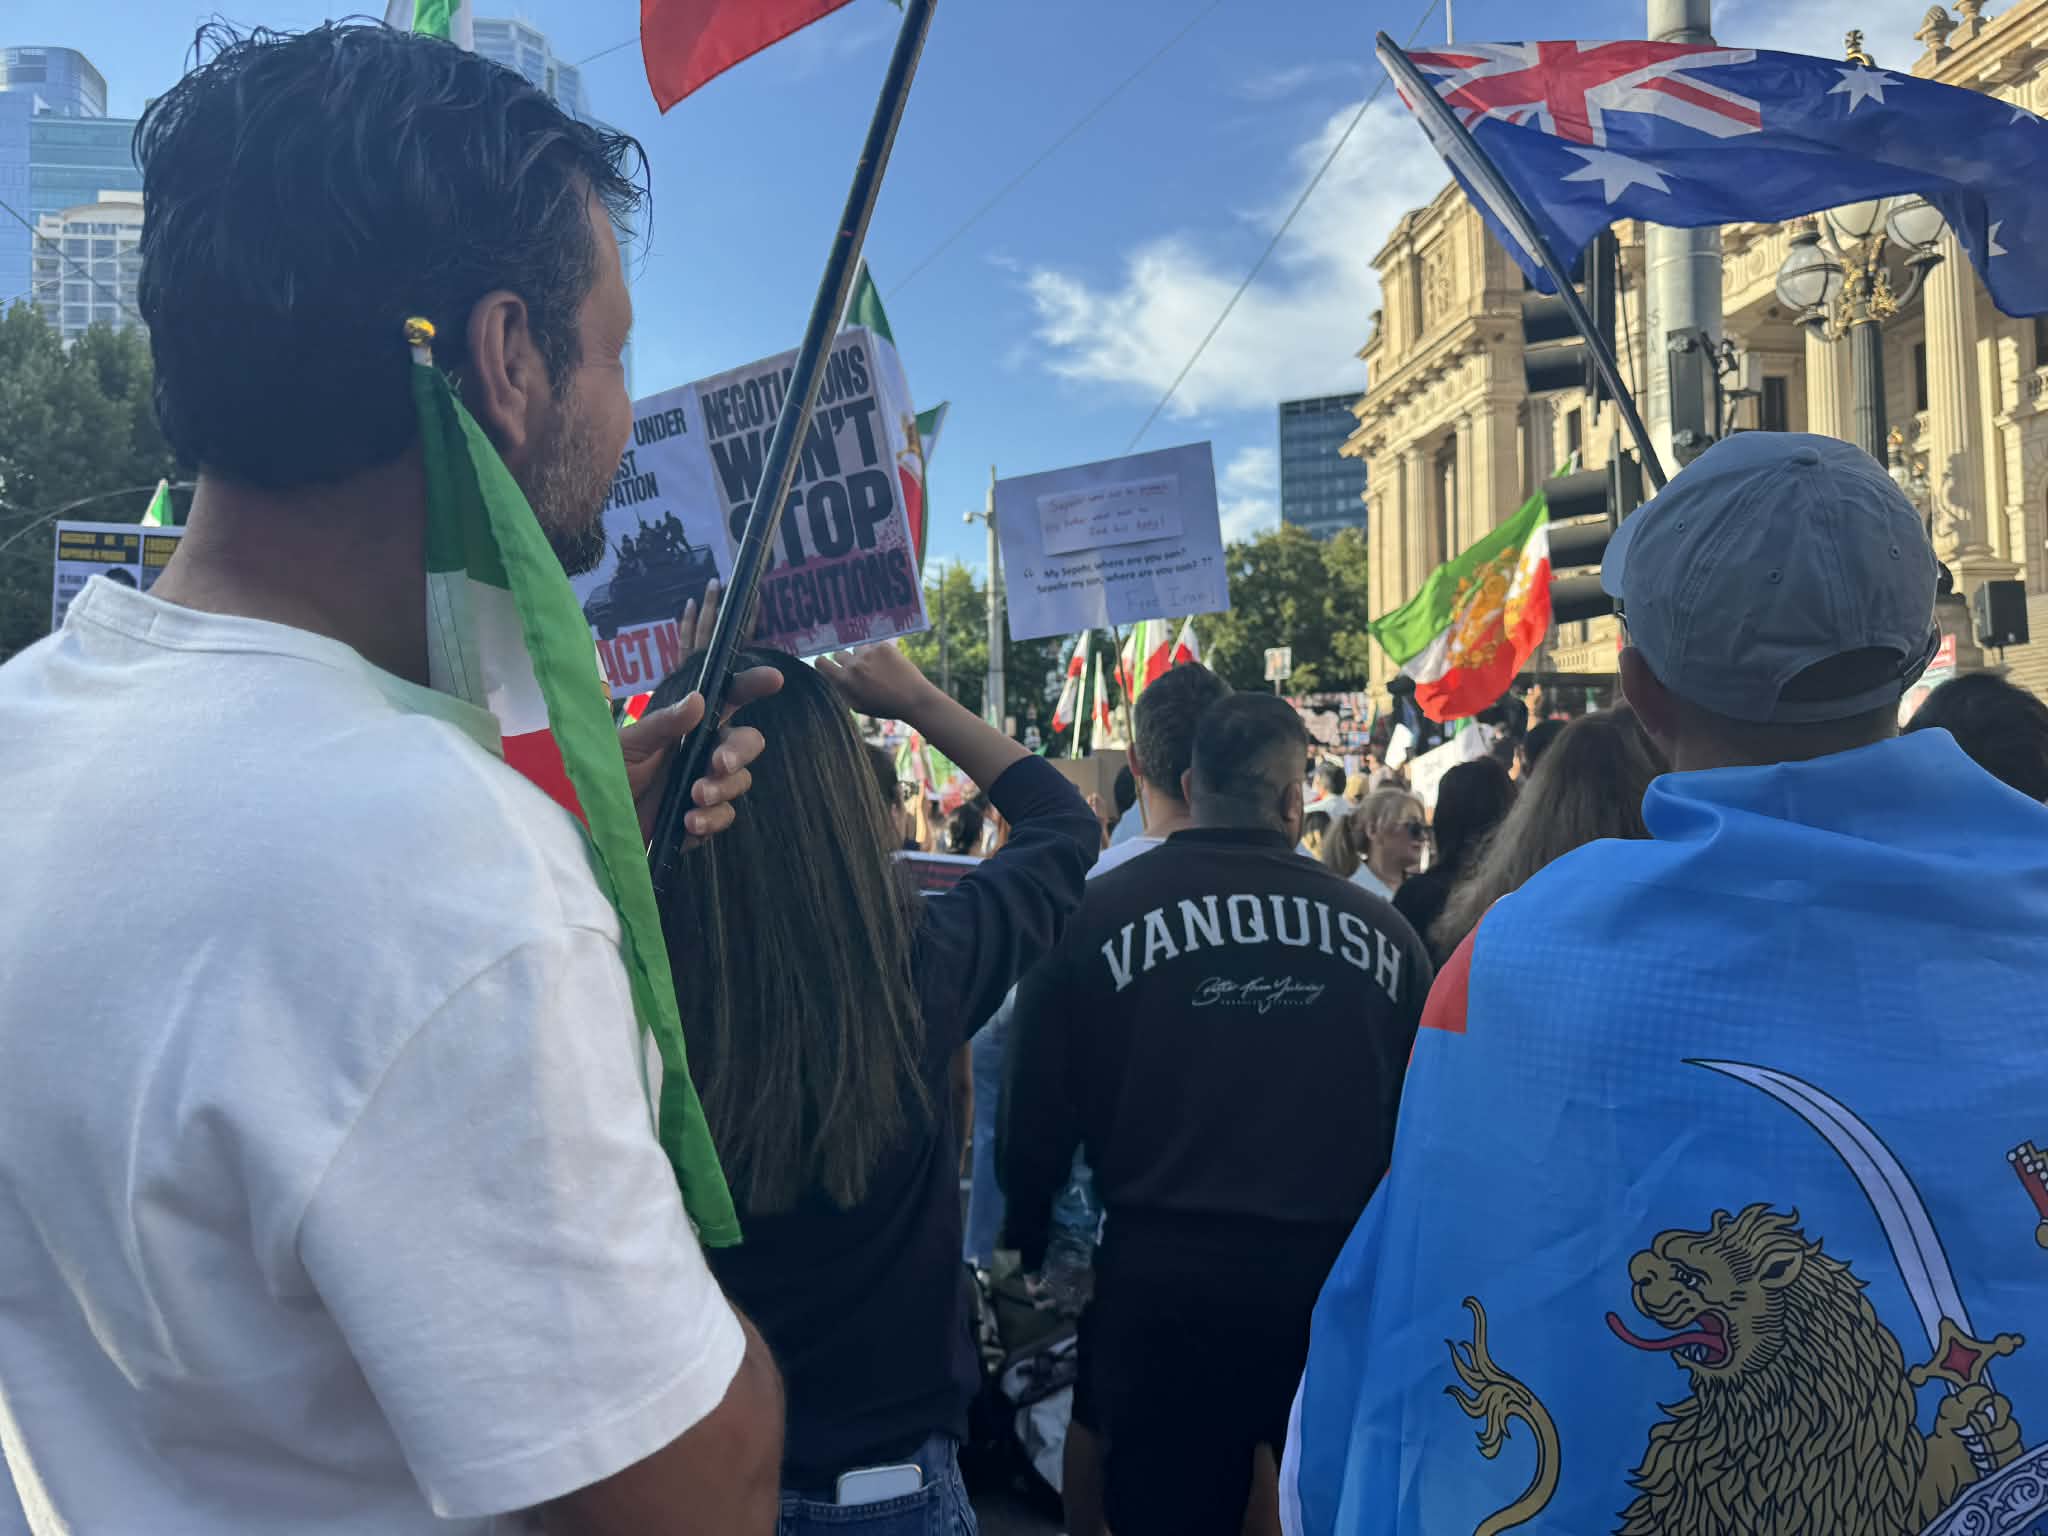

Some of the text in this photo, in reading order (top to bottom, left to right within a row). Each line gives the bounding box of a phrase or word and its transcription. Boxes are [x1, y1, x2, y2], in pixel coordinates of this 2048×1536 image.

[633, 407, 687, 446] UNDER
[702, 345, 869, 440] NEGOTIONS
[709, 397, 878, 504] WN'T
[752, 548, 912, 640] XECUTIONS
[1101, 893, 1401, 1004] VANQUISH
